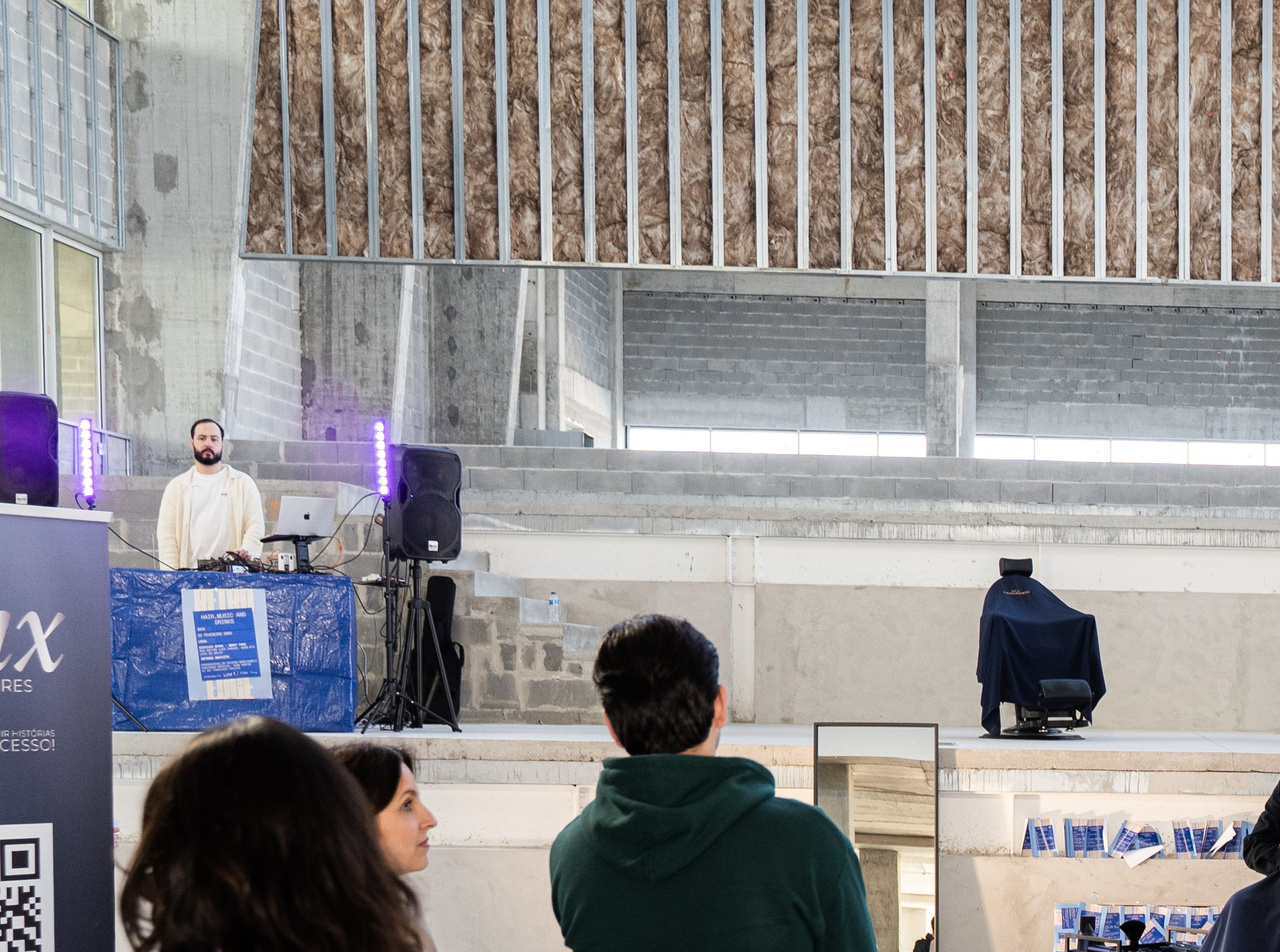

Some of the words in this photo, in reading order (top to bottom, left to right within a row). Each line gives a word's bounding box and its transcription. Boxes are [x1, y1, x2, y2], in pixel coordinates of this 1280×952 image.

[1, 678, 33, 693] RES
[12, 728, 56, 738] HISTÓRIAS
[0, 738, 56, 752] CESSO!
